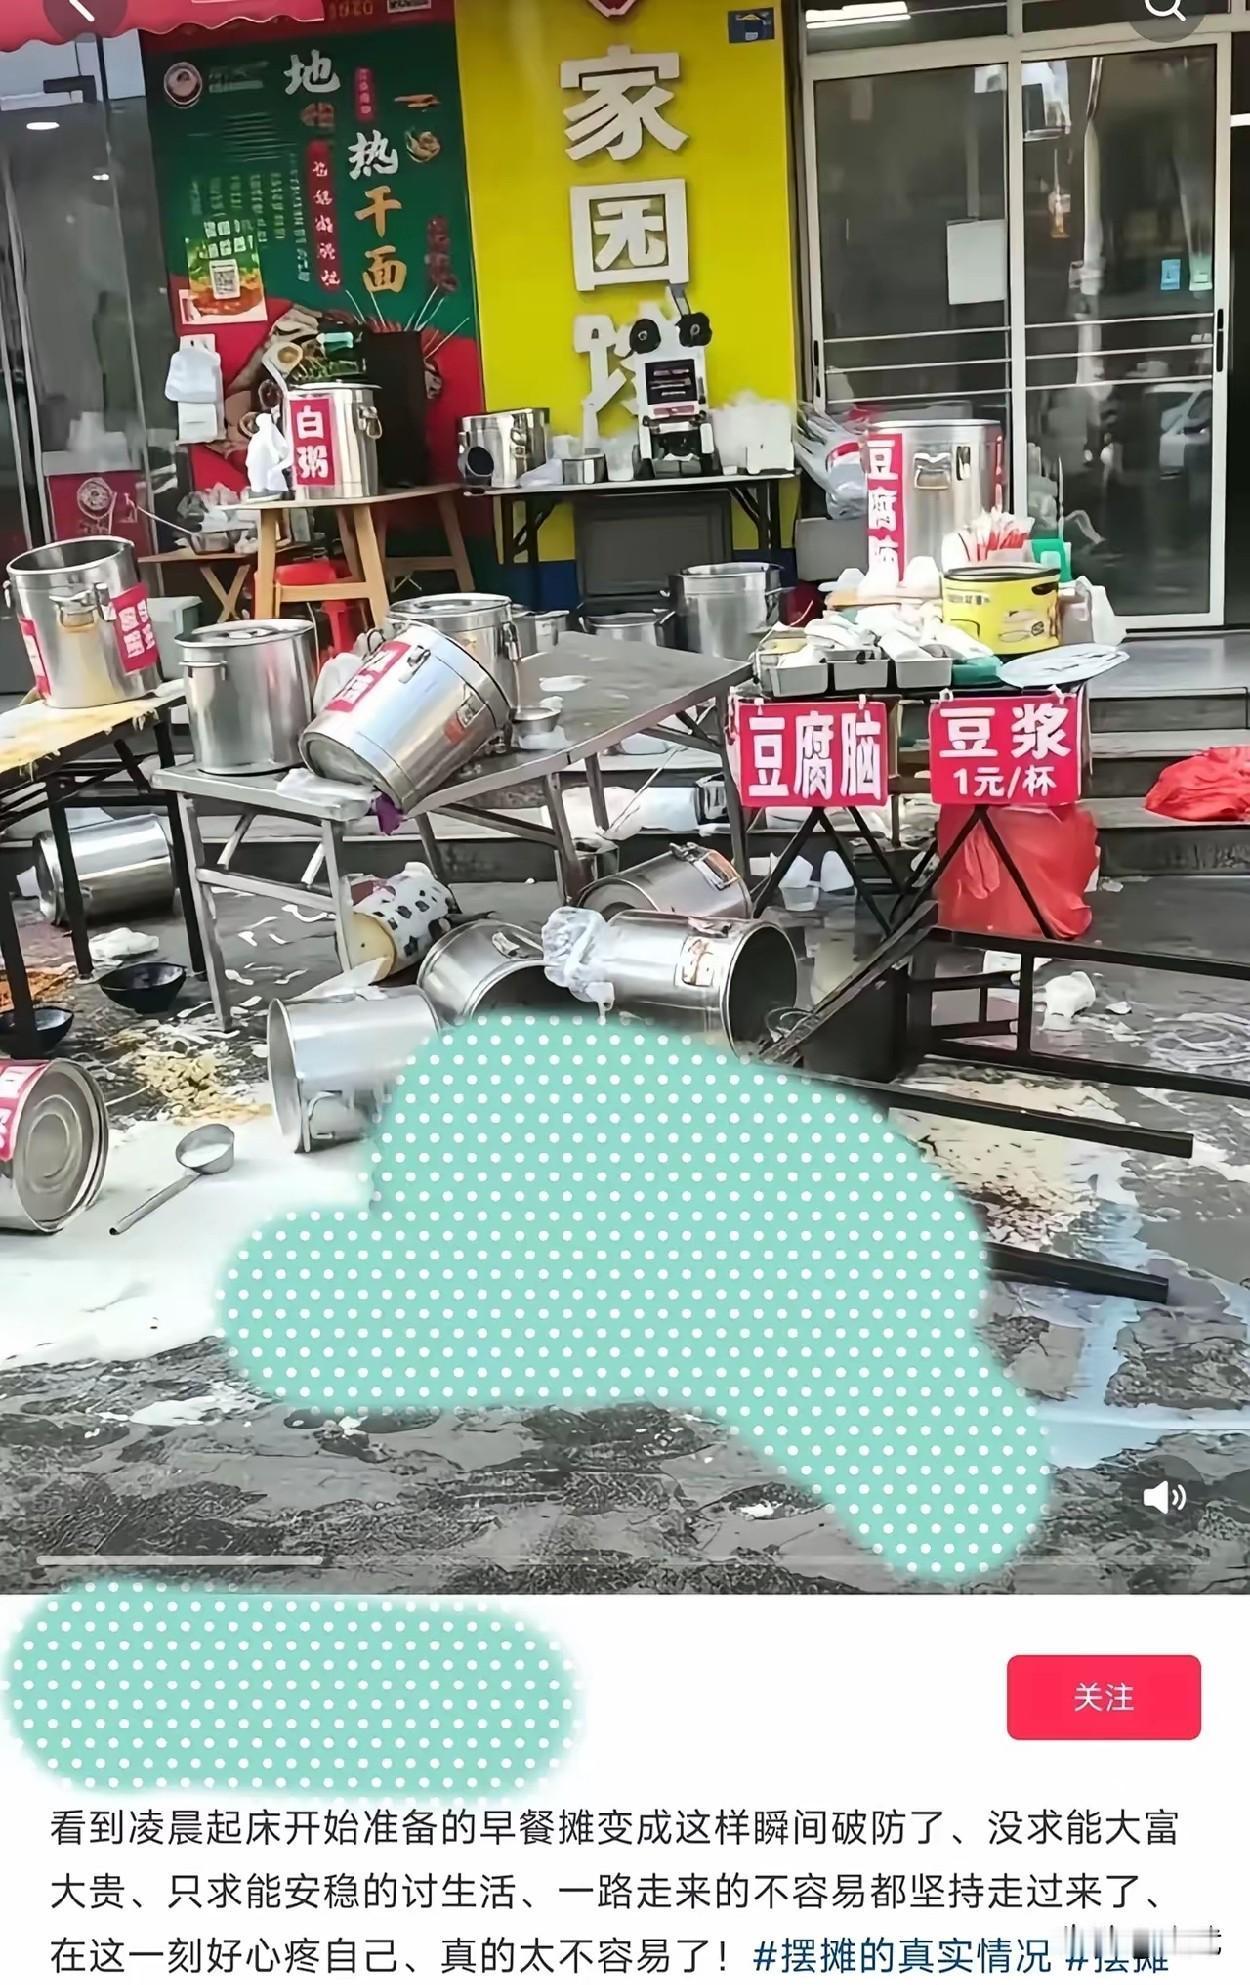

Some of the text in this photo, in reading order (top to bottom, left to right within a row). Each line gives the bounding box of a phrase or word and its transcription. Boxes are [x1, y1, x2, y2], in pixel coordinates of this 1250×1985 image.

[284, 50, 341, 95] 地
[348, 130, 407, 292] 热干面
[296, 404, 328, 478] 白粥
[748, 710, 882, 800] 豆腐脑
[939, 703, 1072, 760] 豆浆
[953, 765, 1057, 799] 1元/杯
